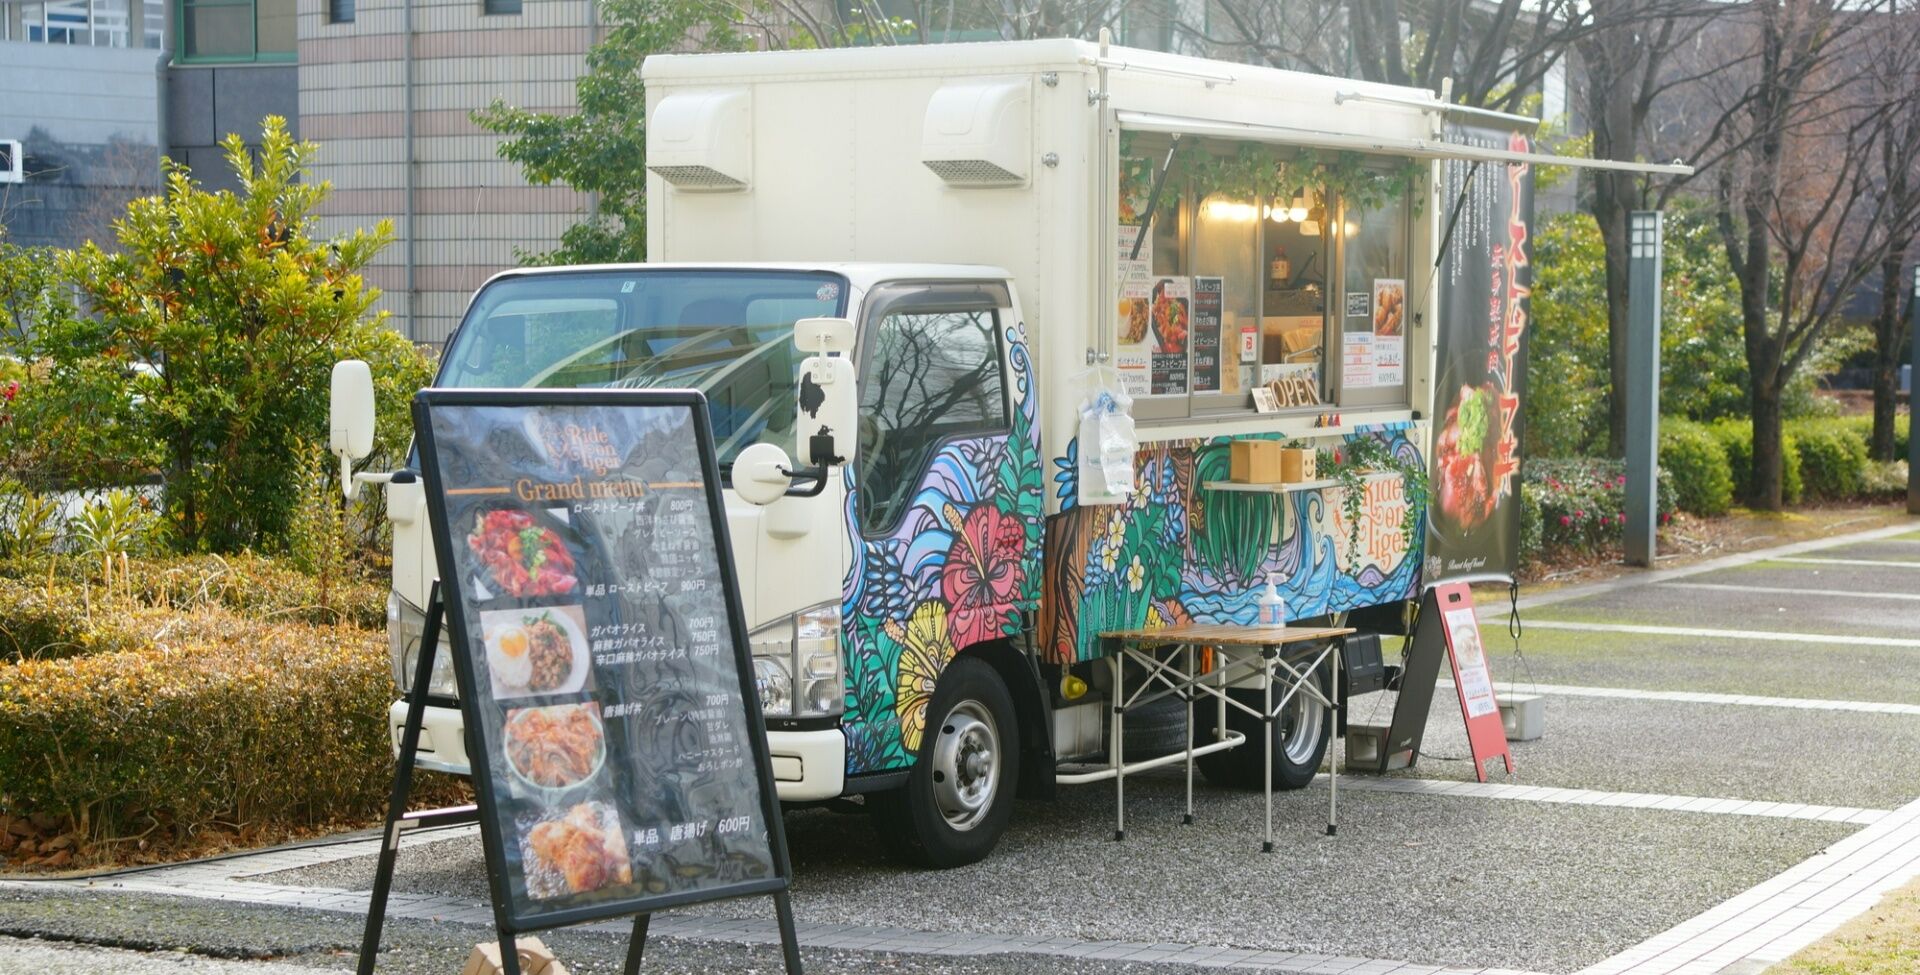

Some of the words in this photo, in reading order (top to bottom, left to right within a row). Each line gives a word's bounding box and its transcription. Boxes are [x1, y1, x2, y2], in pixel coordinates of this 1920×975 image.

[1271, 378, 1320, 408] OPEN
[564, 424, 608, 445] Ride
[517, 475, 585, 501] Grand
[588, 480, 645, 499] menu
[573, 501, 646, 514] ローストビーフ丼
[670, 500, 694, 512] 800円
[585, 584, 606, 597] 単品
[608, 582, 669, 594] ローストビーフ
[680, 579, 706, 592] 900円
[591, 623, 646, 638] ガパオライス
[689, 616, 714, 629] 700円
[691, 630, 717, 642] 750円
[694, 643, 719, 656] 750円
[603, 702, 642, 718] 唐揚げ丼
[705, 694, 729, 706] 700円
[678, 744, 740, 760] ハニーマスタード
[633, 828, 659, 846] 単品
[670, 820, 708, 842] 唐揚げ
[718, 816, 750, 834] 600円
